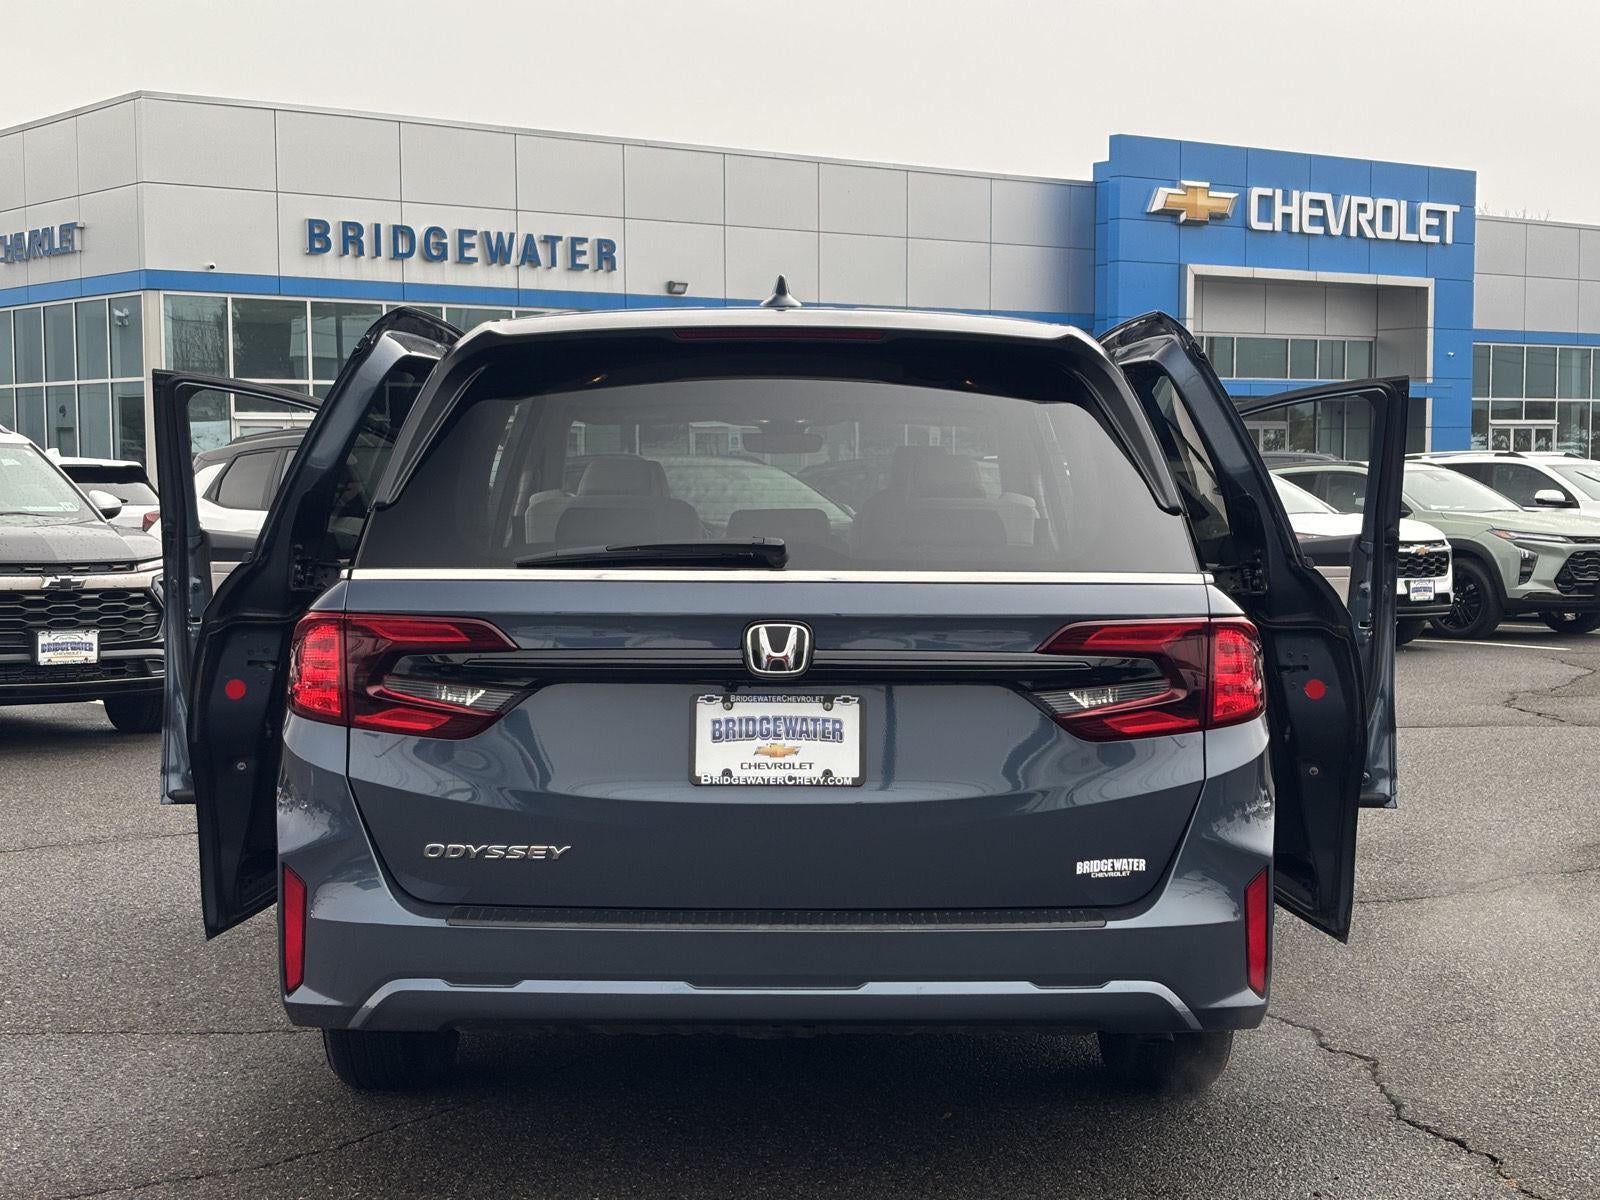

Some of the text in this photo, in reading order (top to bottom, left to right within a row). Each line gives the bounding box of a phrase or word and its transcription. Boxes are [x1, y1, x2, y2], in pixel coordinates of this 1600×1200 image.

[1248, 187, 1461, 244] CHEVROLET
[304, 217, 618, 272] BRIDGEWATER
[711, 715, 845, 743] BRIDGEWATER
[740, 762, 815, 770] CHEVROLET
[423, 843, 571, 860] ODYSSEY
[1076, 858, 1146, 875] BRIDGEWATER
[1091, 870, 1130, 878] CHEVROLET
